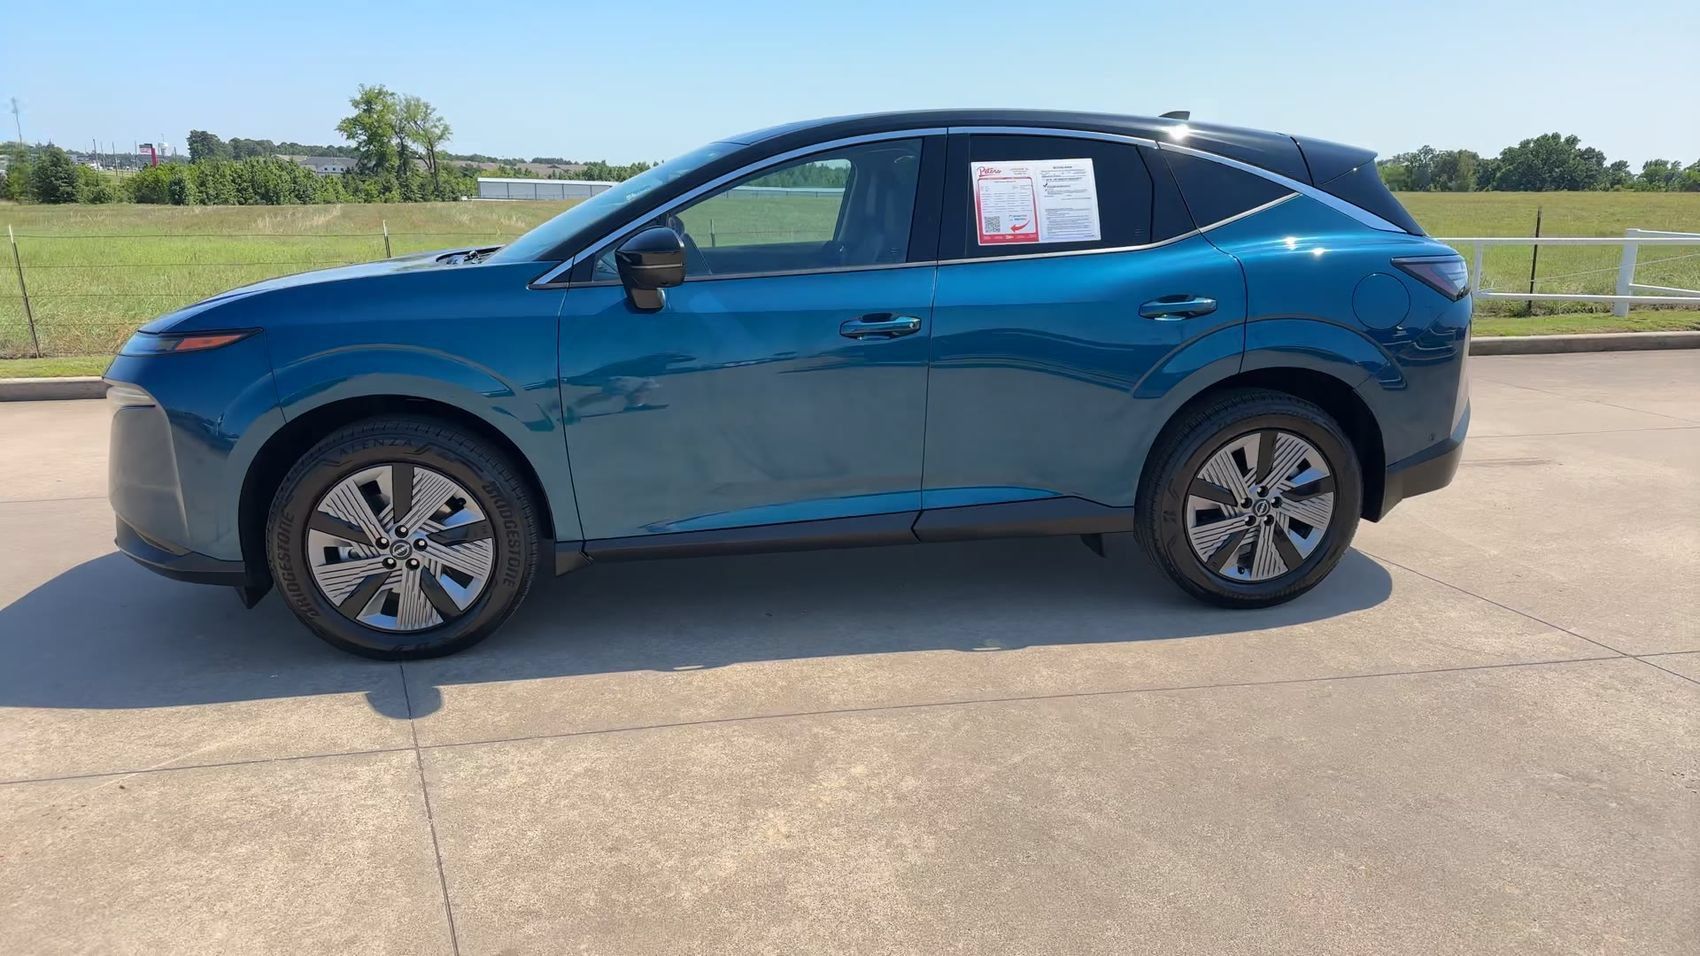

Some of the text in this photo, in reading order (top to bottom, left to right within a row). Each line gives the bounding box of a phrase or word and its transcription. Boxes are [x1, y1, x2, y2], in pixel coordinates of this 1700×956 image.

[339, 438, 413, 457] ALENZA
[277, 511, 321, 618] BRIDGESTONE
[481, 480, 521, 587] BRIDGESTONE
